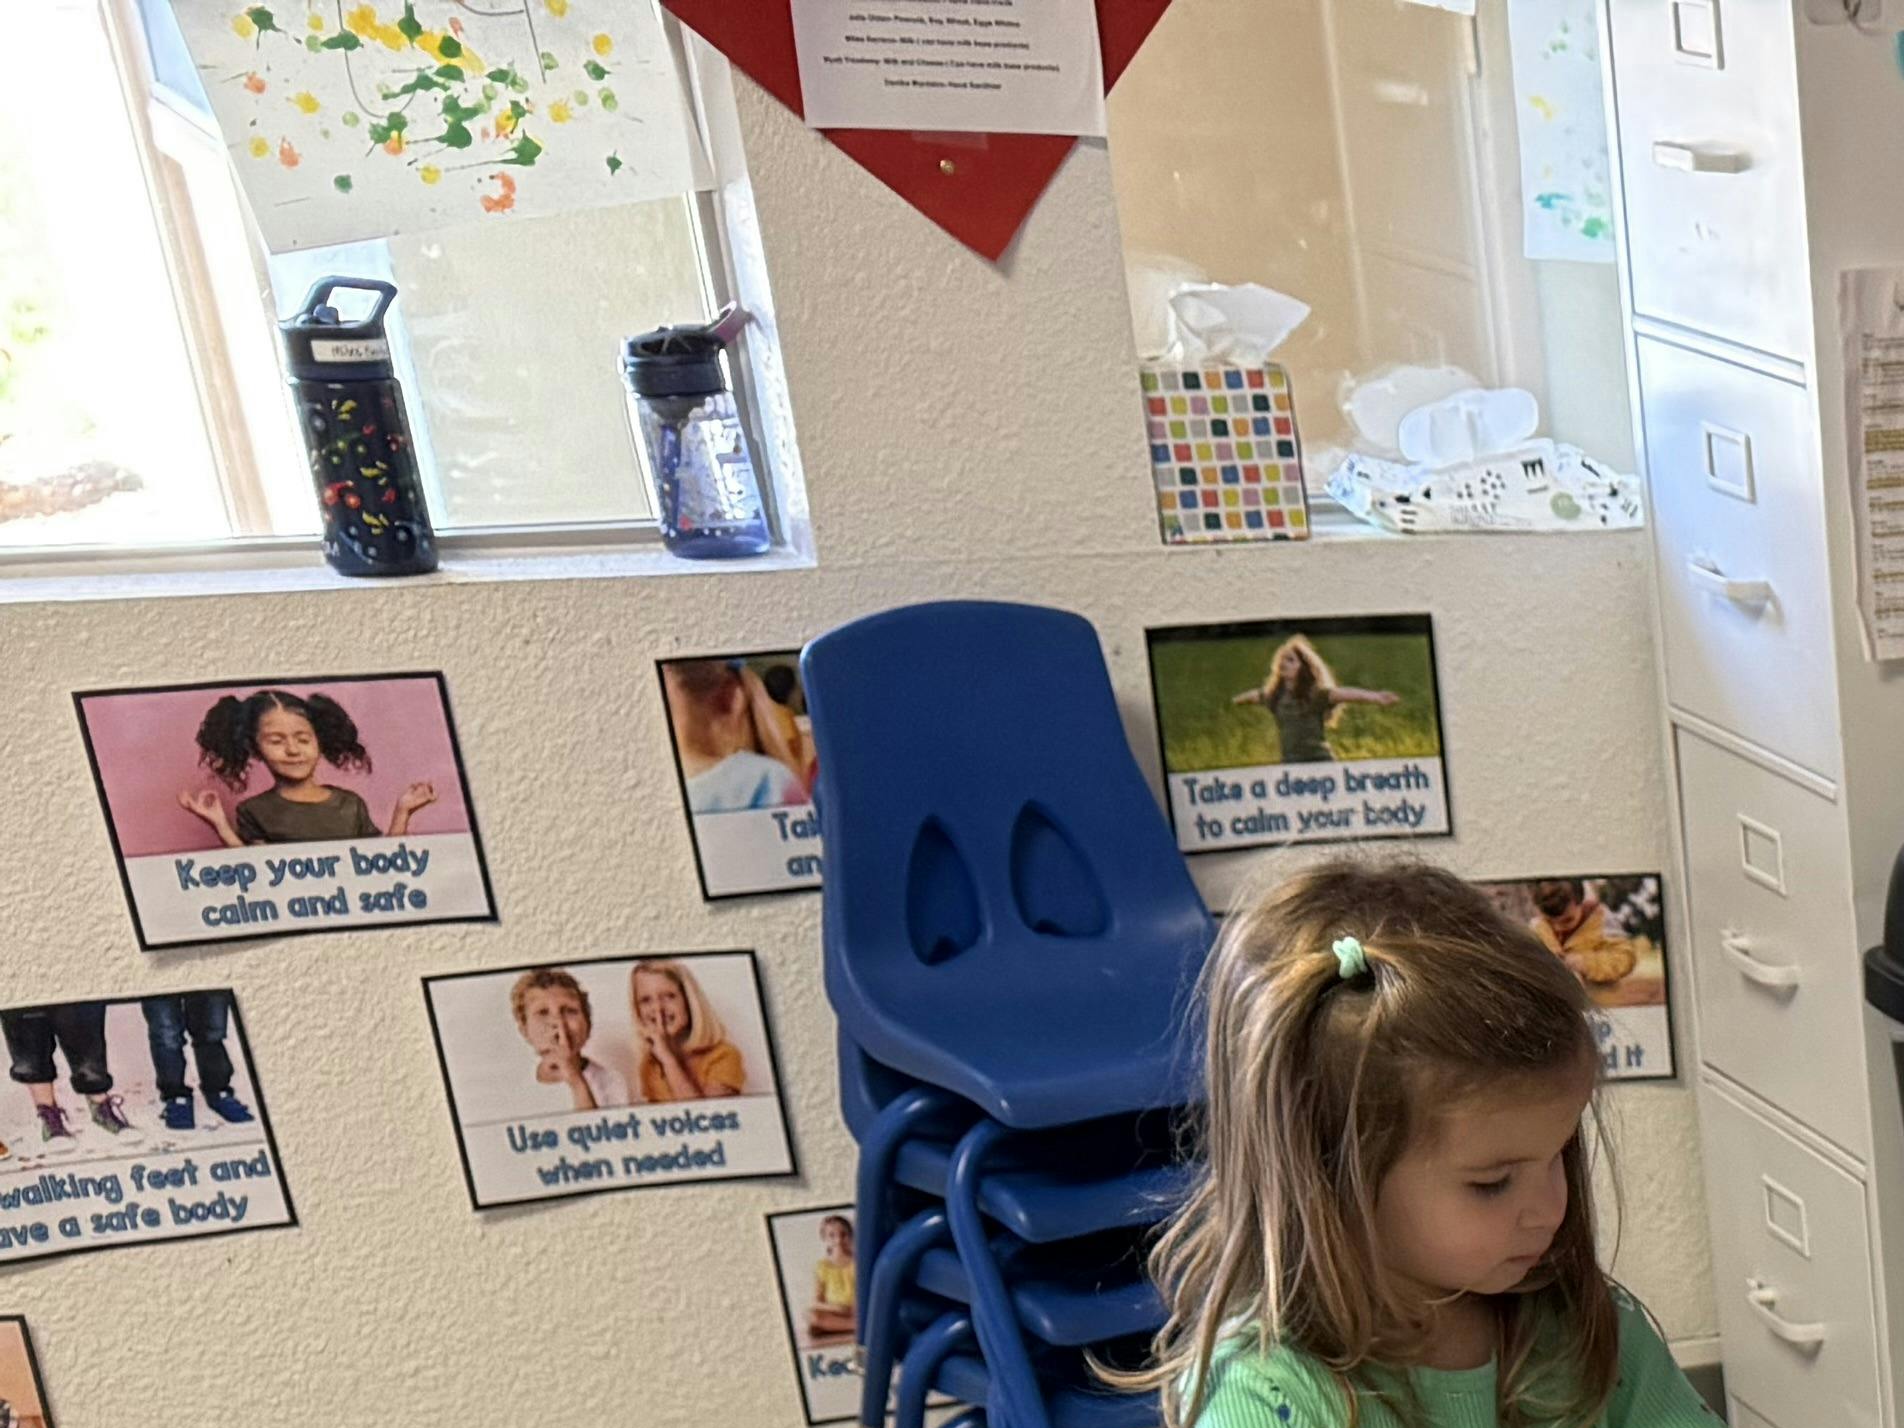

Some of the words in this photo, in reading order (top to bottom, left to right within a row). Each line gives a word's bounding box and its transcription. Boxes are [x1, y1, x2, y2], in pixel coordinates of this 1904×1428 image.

[1182, 776, 1243, 806] Take
[1250, 779, 1267, 799] a
[1276, 771, 1336, 801] deep
[1343, 764, 1429, 793] breath
[1195, 812, 1224, 840] to
[1231, 806, 1290, 836] calm
[1296, 808, 1355, 834] your
[1361, 798, 1427, 828] body
[175, 858, 257, 892] Keep
[265, 854, 341, 887] your
[349, 843, 430, 877] body
[201, 894, 280, 927] calm
[287, 885, 349, 918] and
[359, 882, 429, 912] safe
[506, 1124, 559, 1153] Use
[567, 1112, 642, 1152] quiet
[650, 1108, 741, 1136] voices
[130, 1158, 199, 1192] feet
[210, 1150, 272, 1182] and
[537, 1156, 615, 1187] when
[621, 1140, 727, 1176] needed
[0, 1221, 50, 1250] ave
[58, 1216, 82, 1239] a
[90, 1202, 161, 1234] safe
[168, 1191, 249, 1225] body
